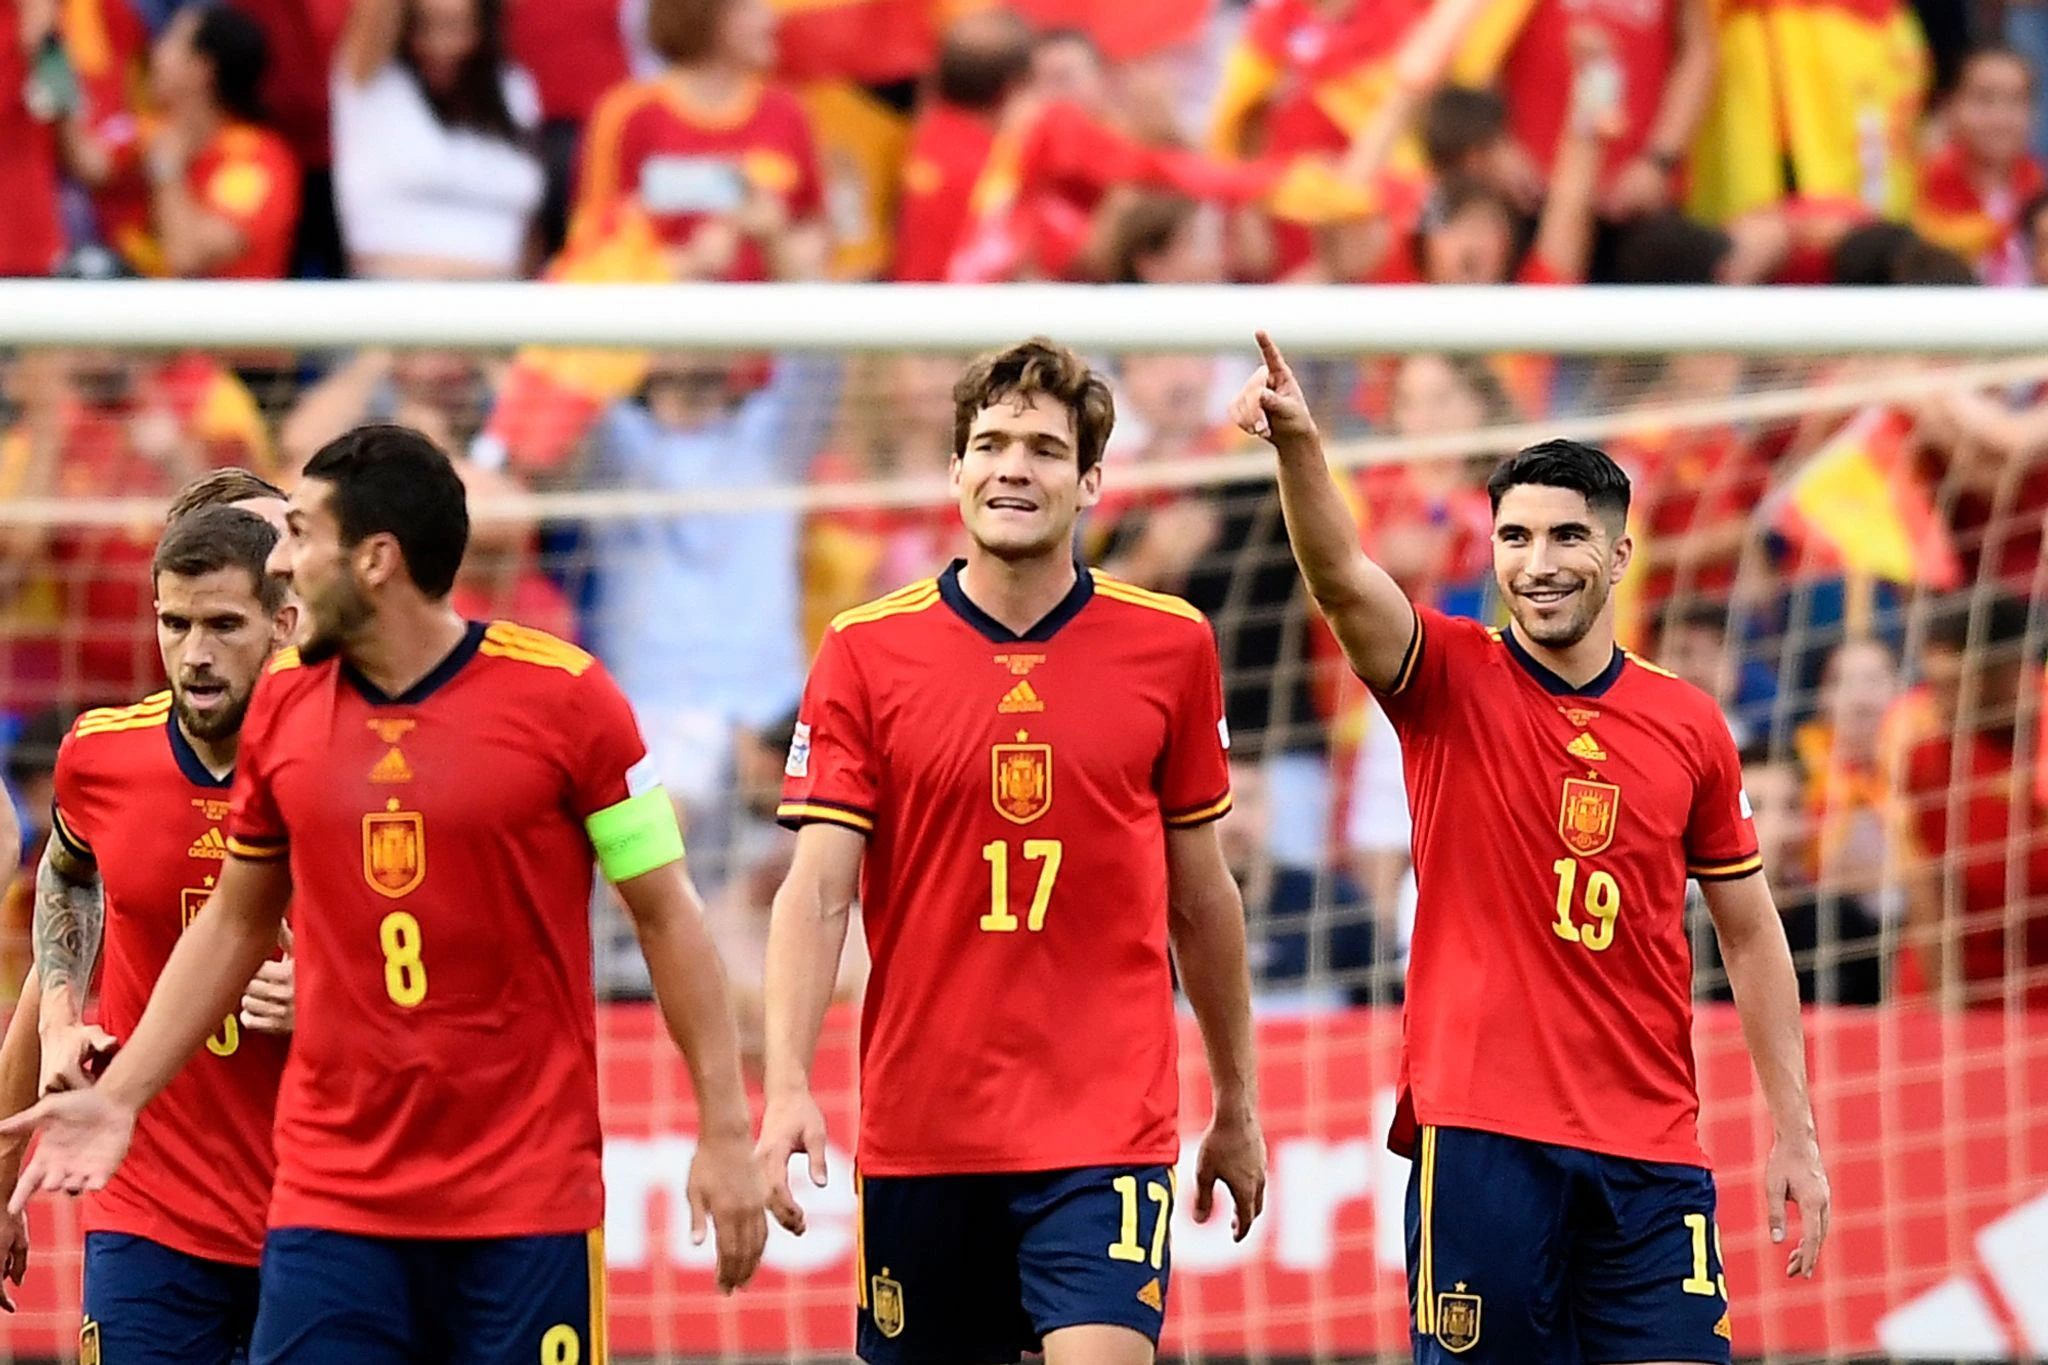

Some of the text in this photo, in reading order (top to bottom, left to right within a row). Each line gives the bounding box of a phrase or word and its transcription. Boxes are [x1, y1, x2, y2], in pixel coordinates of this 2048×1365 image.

[980, 839, 1062, 932] 17
[1552, 857, 1620, 951] 19
[379, 910, 428, 1008] 8
[1108, 1174, 1169, 1271] 17
[1682, 1213, 1729, 1302] 1
